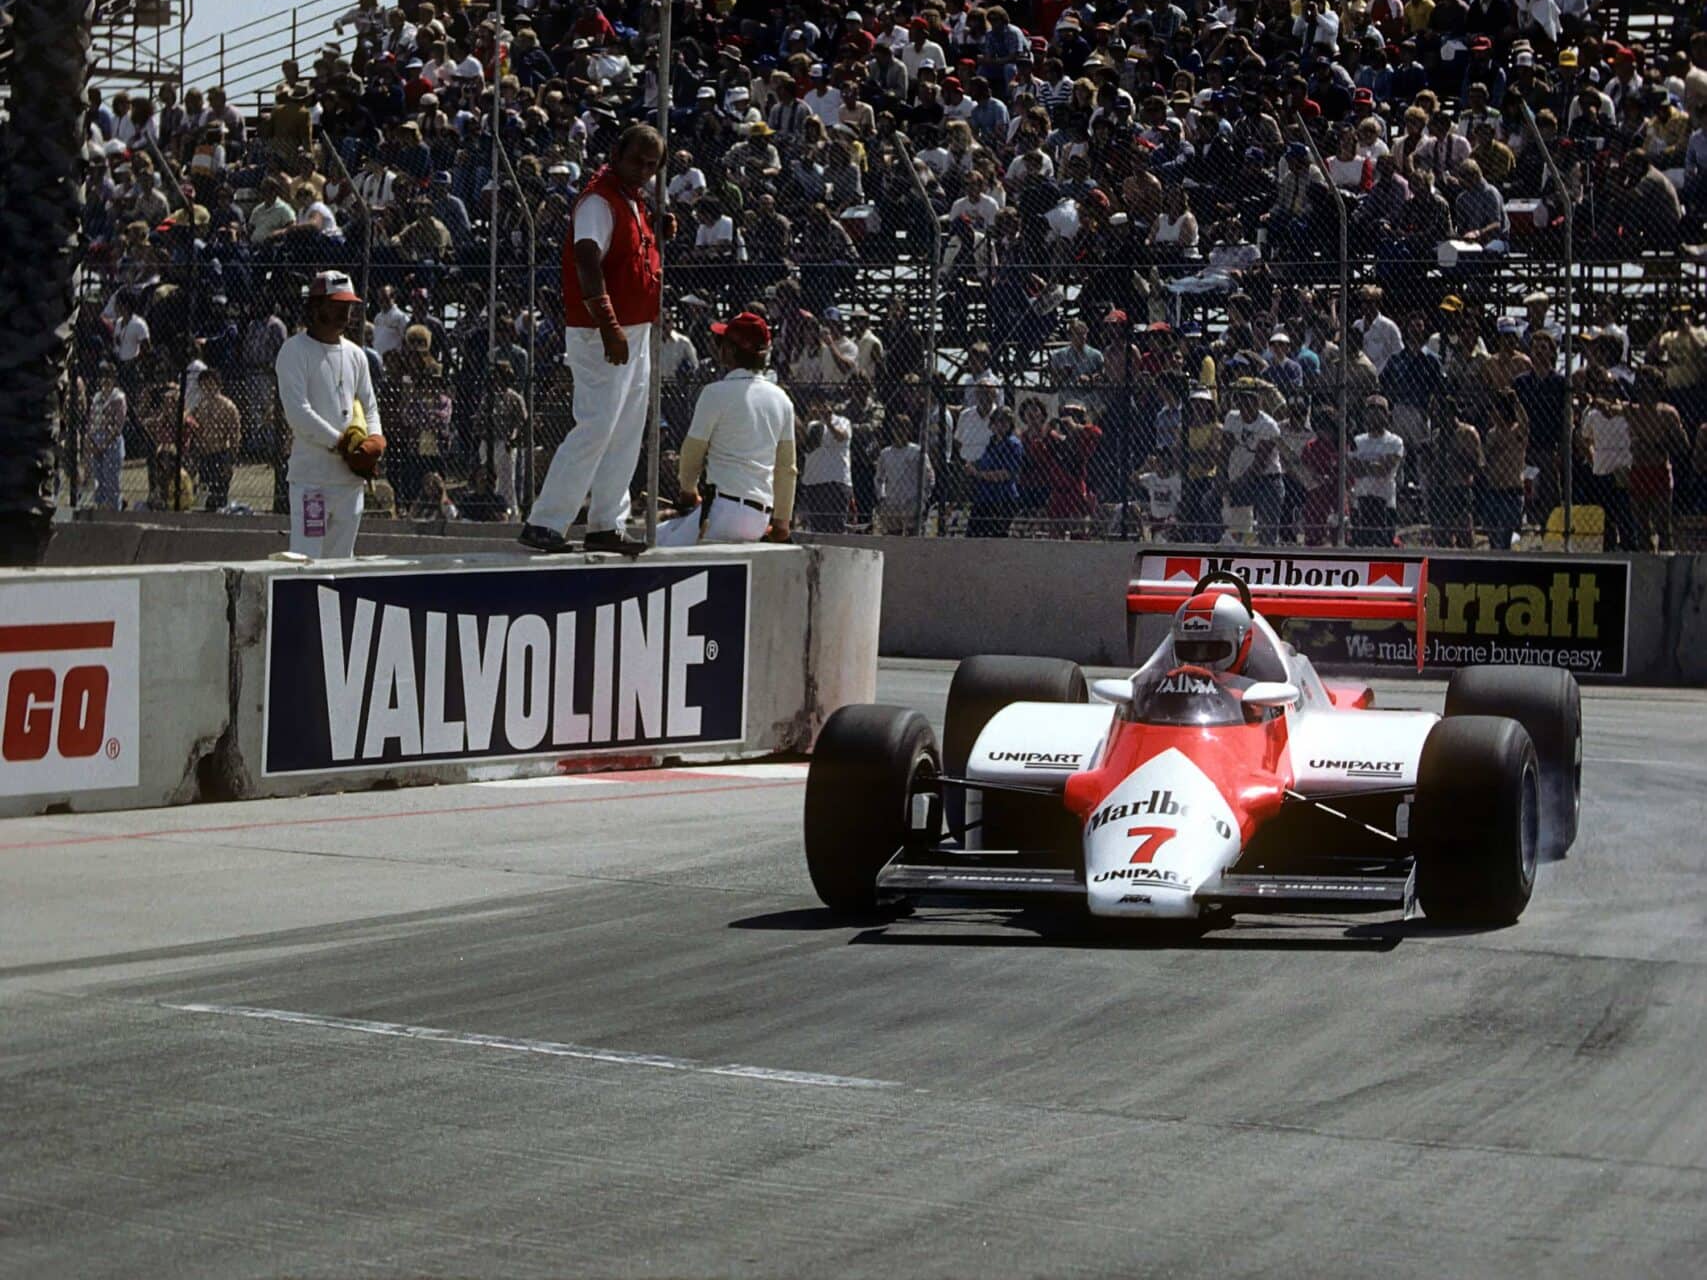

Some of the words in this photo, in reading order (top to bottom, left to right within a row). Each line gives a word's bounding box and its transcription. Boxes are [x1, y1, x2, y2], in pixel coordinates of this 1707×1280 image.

[1207, 558, 1360, 587] Marlboro
[1350, 572, 1600, 638] arratt
[1345, 635, 1375, 658] We
[1434, 639, 1487, 662] home
[1490, 641, 1555, 666] buying
[988, 751, 1083, 763] UNIPART
[1309, 759, 1405, 771] UNIPART
[1087, 790, 1231, 839] Marlbo
[1127, 825, 1177, 864] 7
[1093, 868, 1192, 884] UNIPAR
